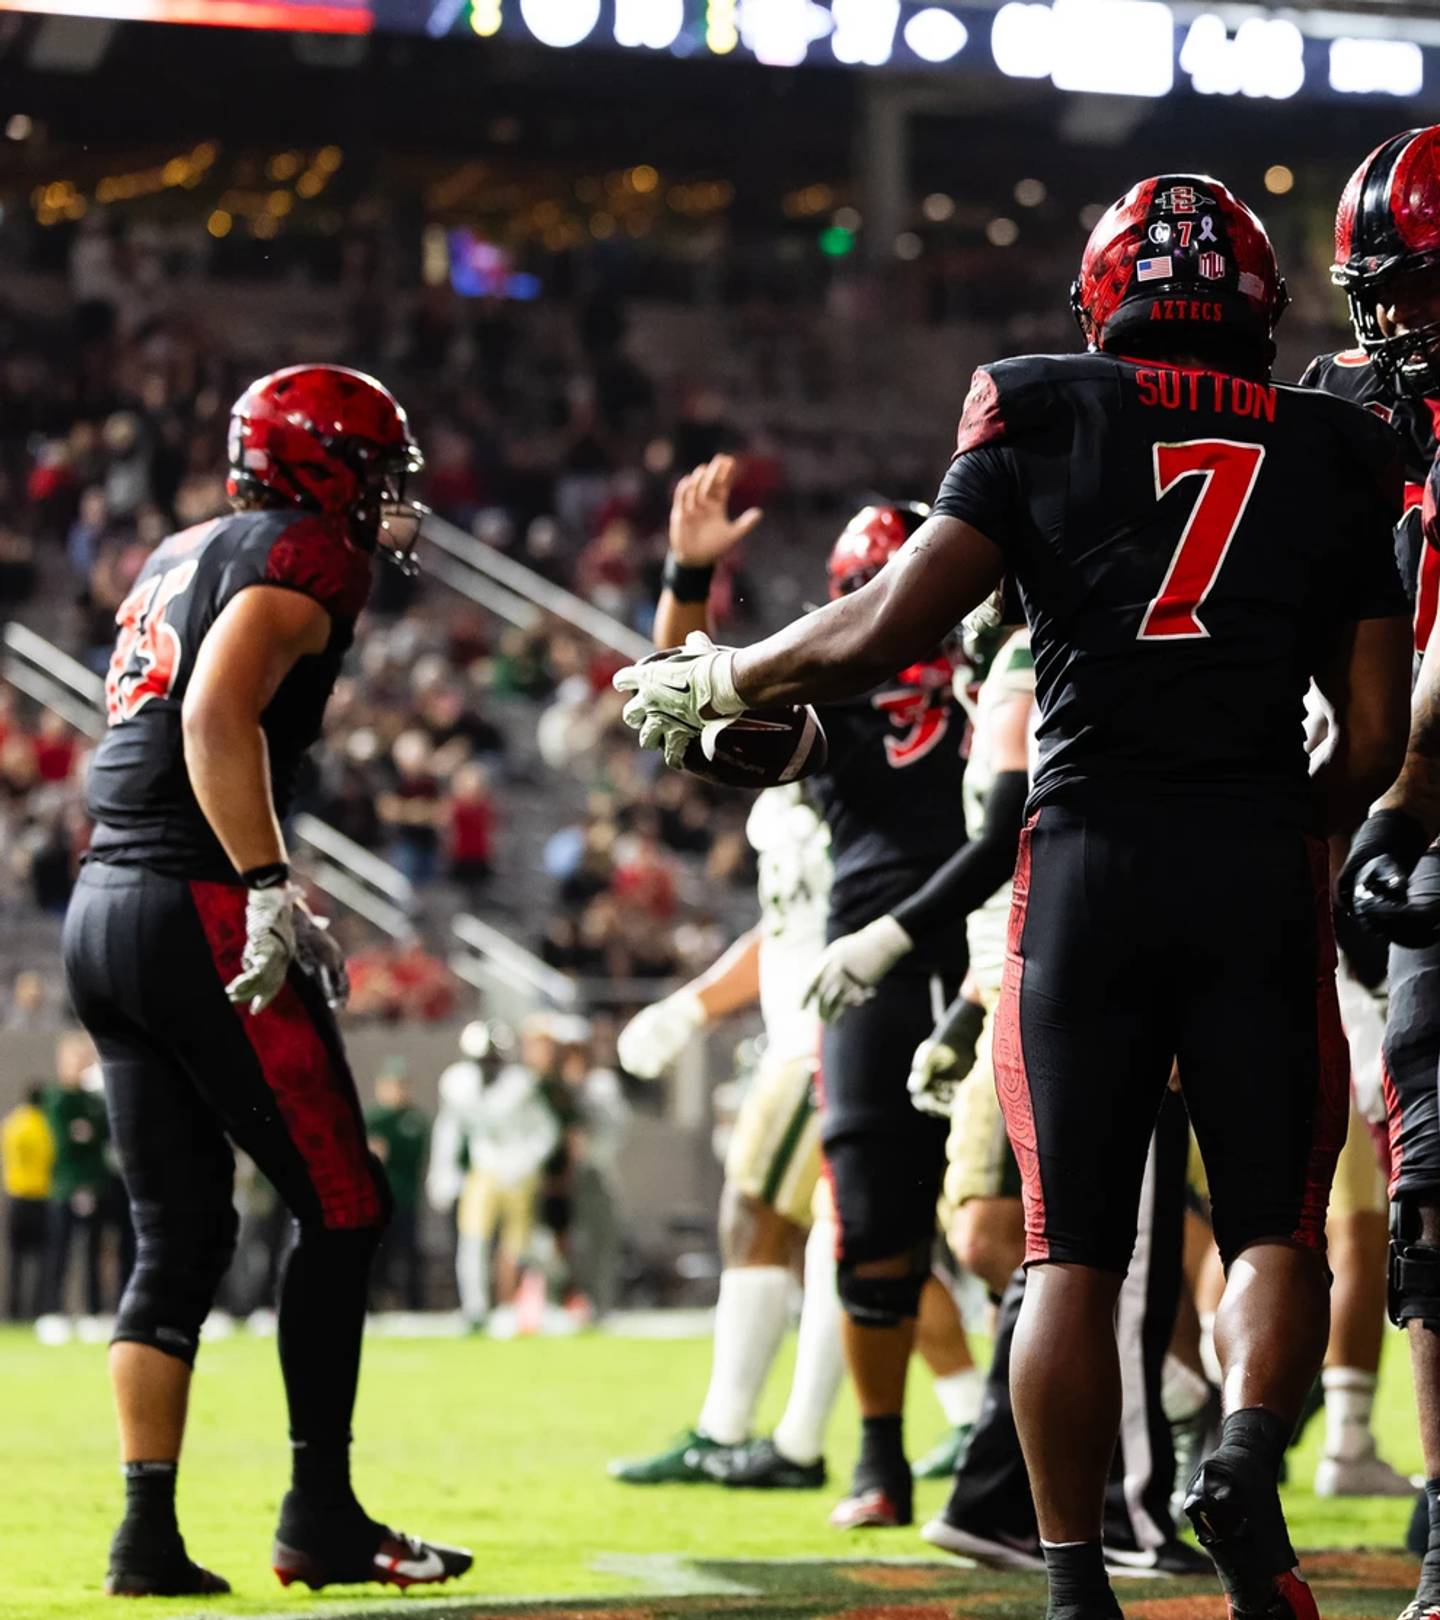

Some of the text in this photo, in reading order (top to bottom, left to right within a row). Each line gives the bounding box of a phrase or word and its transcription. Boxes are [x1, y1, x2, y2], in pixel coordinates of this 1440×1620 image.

[1177, 221, 1192, 248] 7
[1150, 299, 1222, 321] AZTECS
[1135, 369, 1277, 422] SUTTON
[1136, 438, 1266, 641] 7
